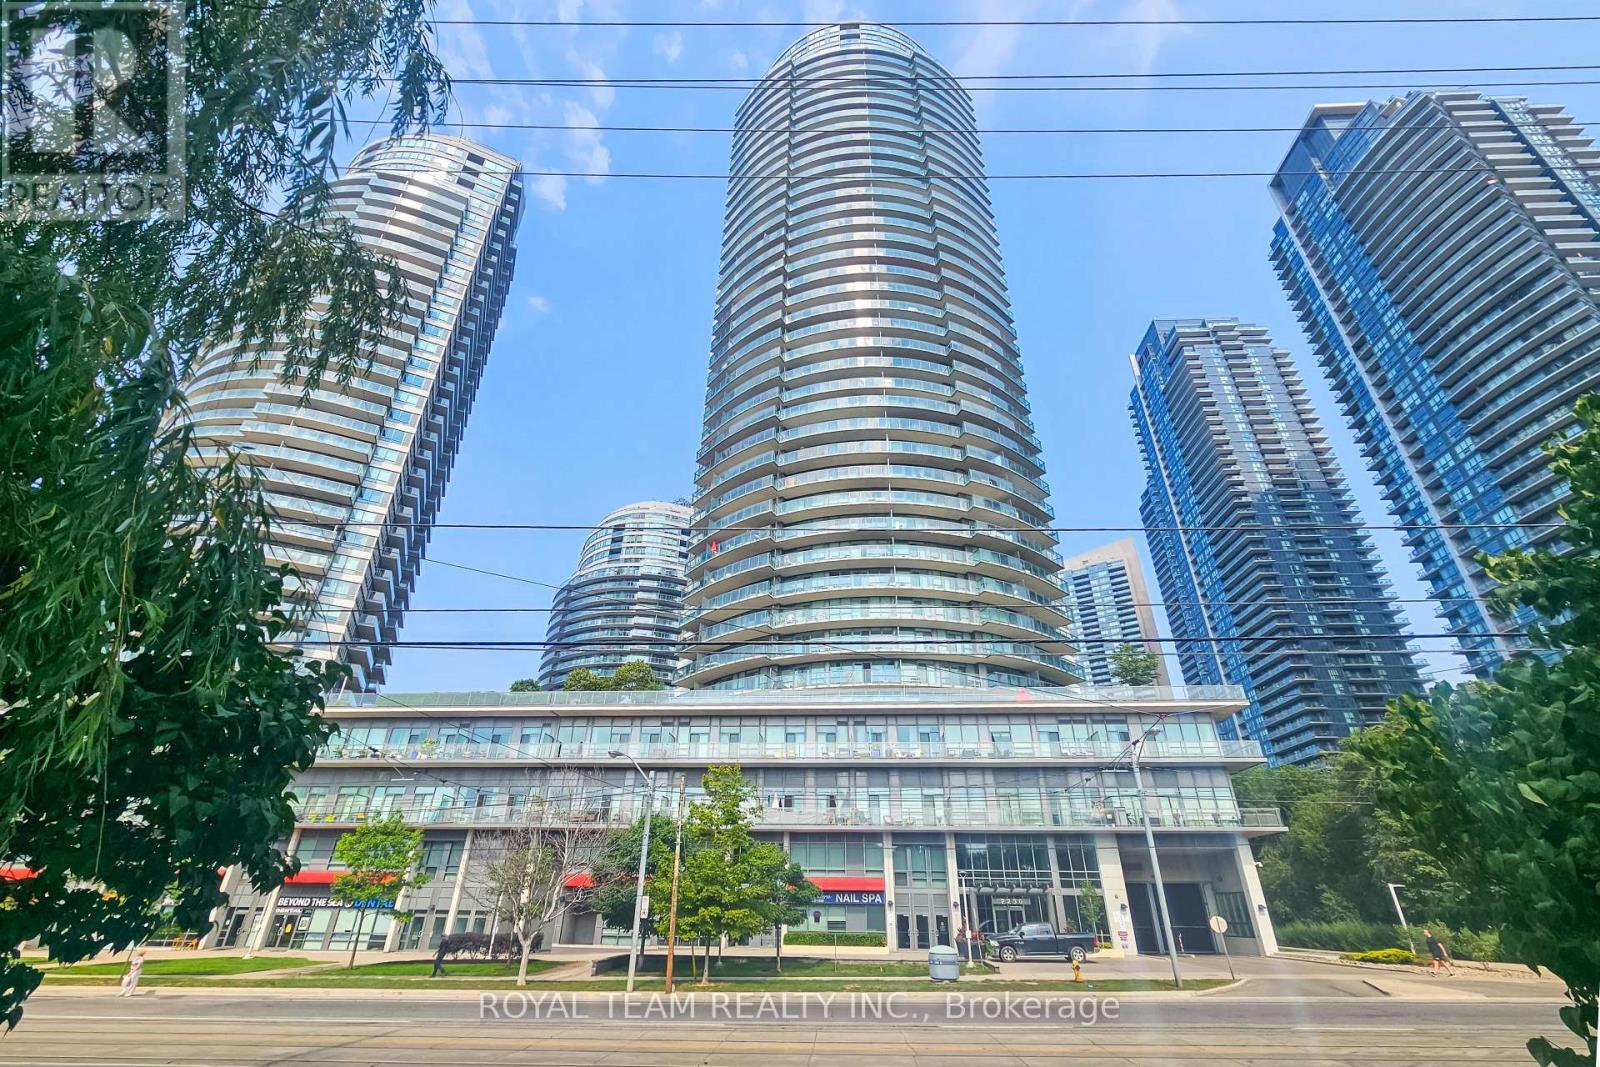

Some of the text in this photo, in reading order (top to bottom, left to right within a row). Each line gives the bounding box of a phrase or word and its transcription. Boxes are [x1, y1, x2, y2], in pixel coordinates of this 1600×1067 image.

[277, 897, 310, 907] BEYOND
[311, 897, 327, 907] THE
[835, 893, 860, 903] NAIL
[861, 893, 883, 903] SPA
